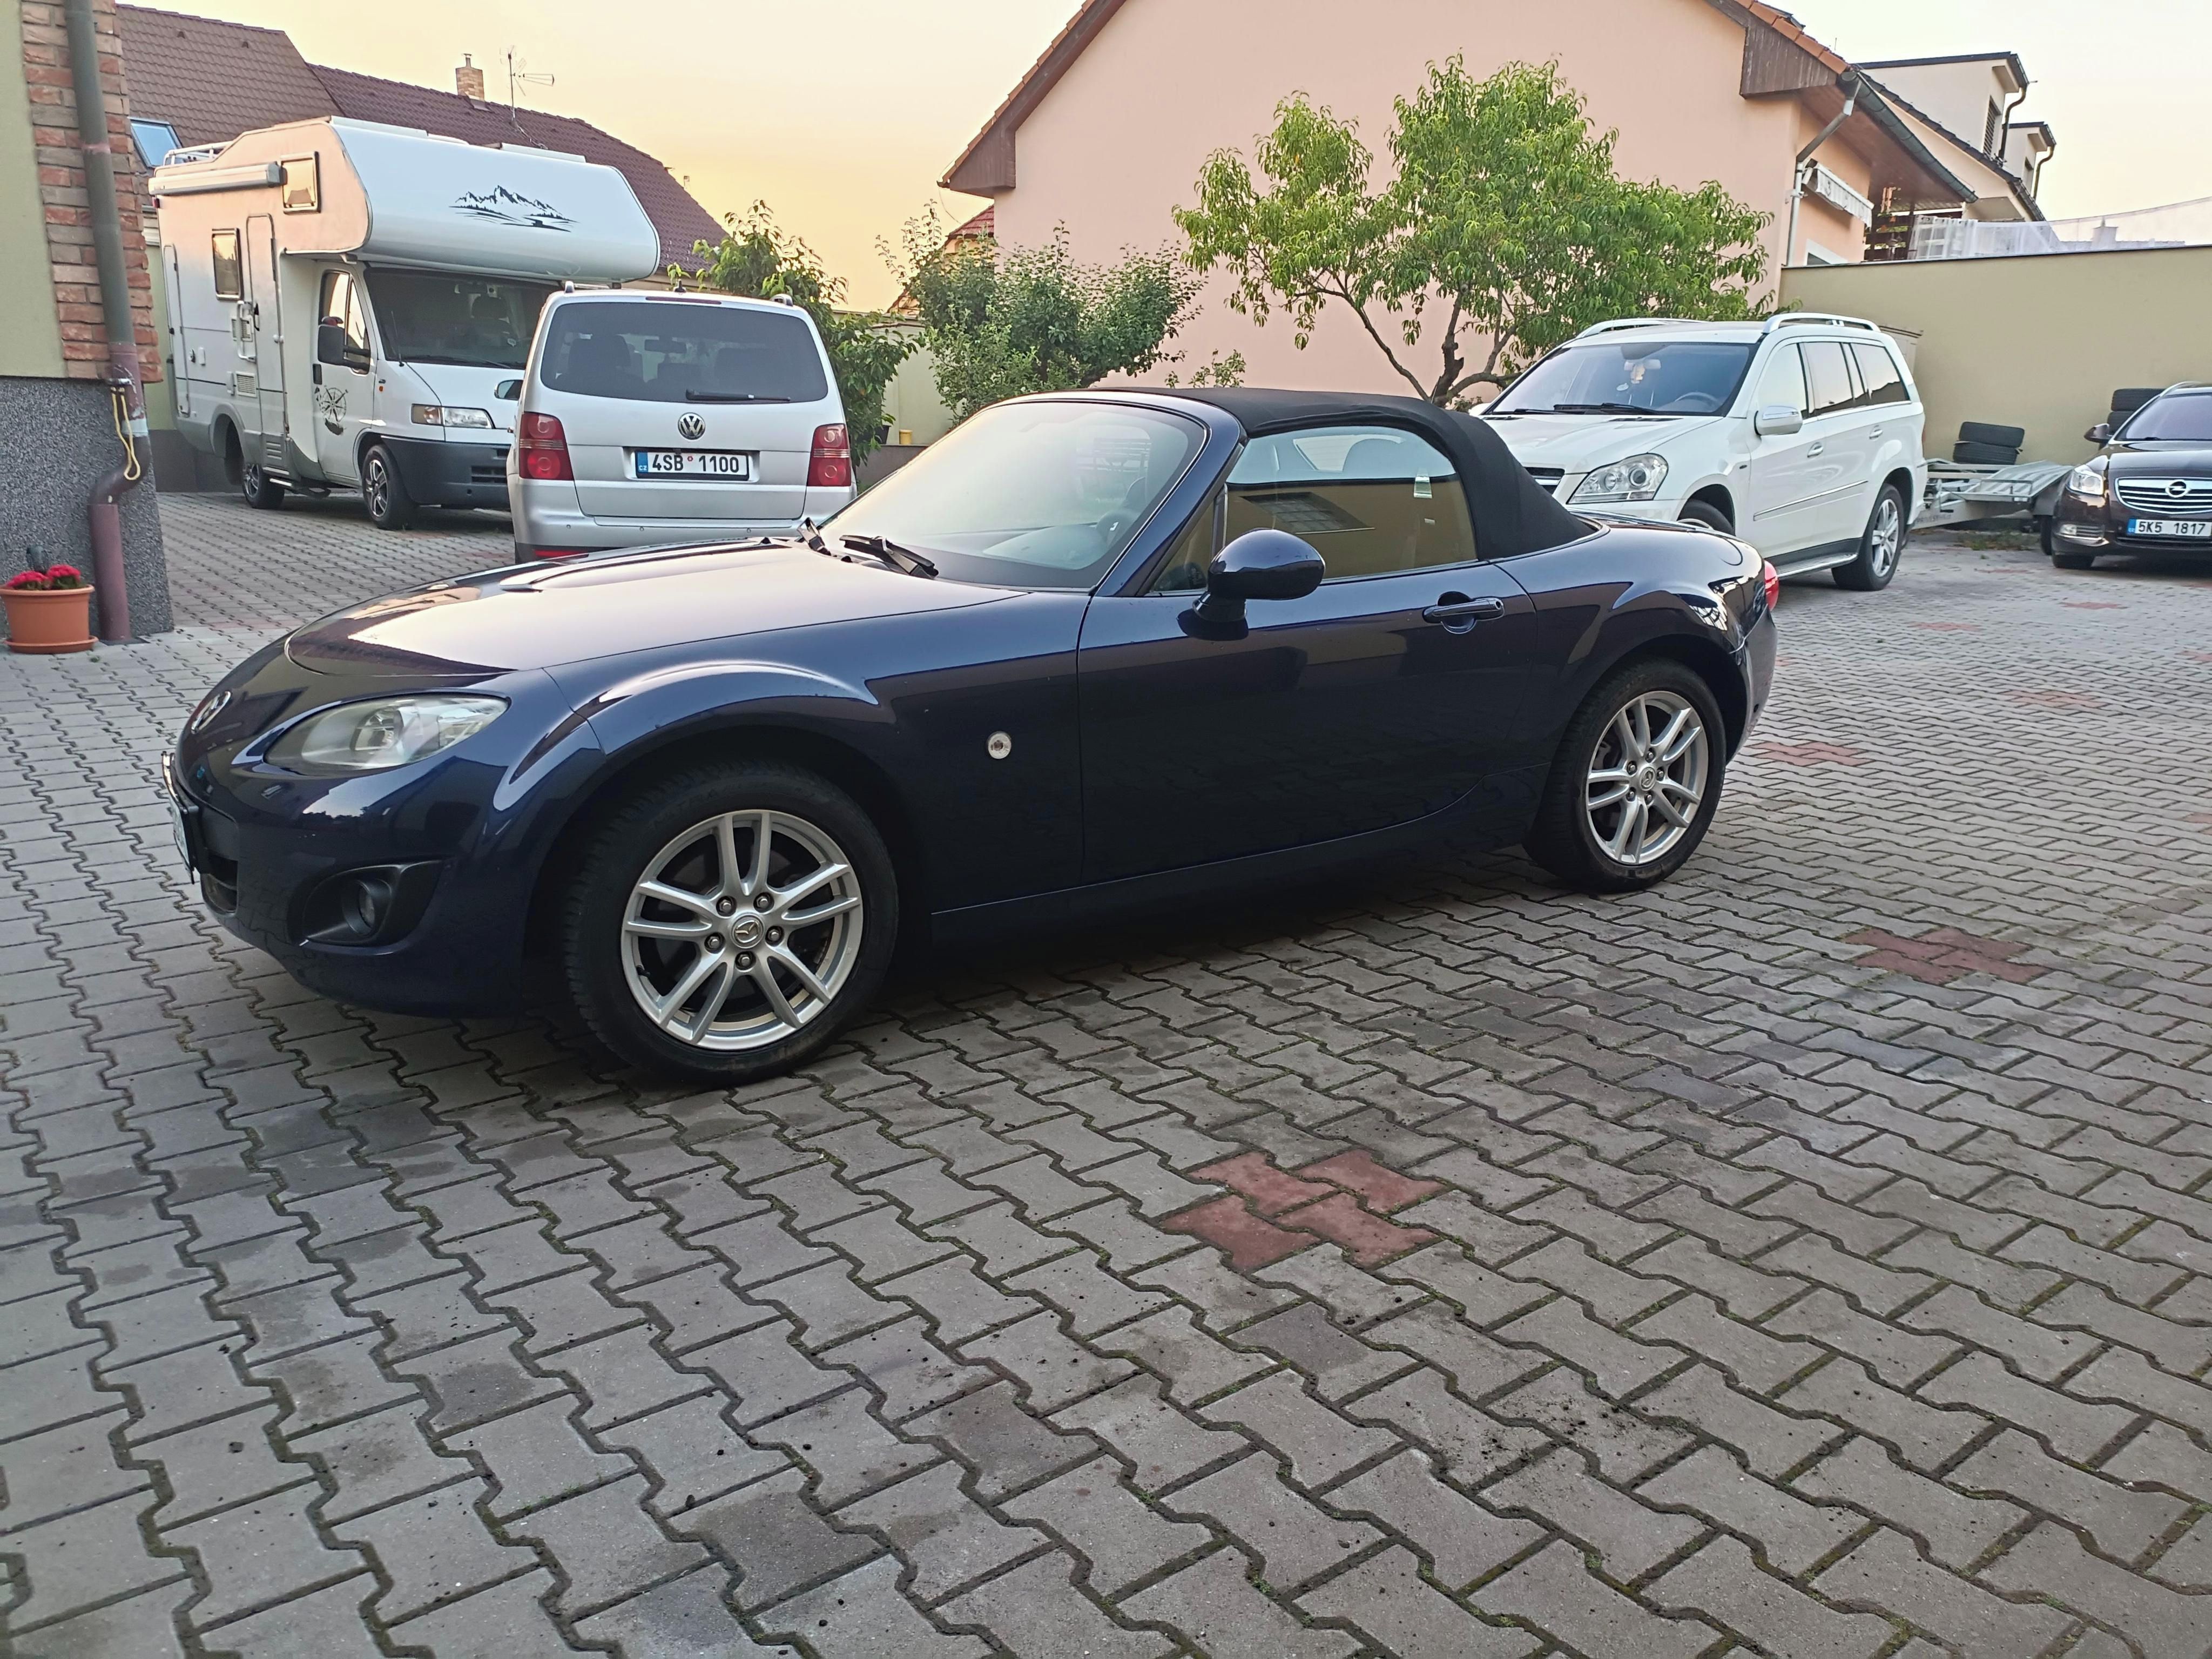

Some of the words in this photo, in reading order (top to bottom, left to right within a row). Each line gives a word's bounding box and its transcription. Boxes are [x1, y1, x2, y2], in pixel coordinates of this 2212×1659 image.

[652, 454, 684, 471] 4SB
[699, 455, 739, 473] 1100
[2138, 521, 2163, 533] 5K5
[2174, 523, 2206, 535] 1817
